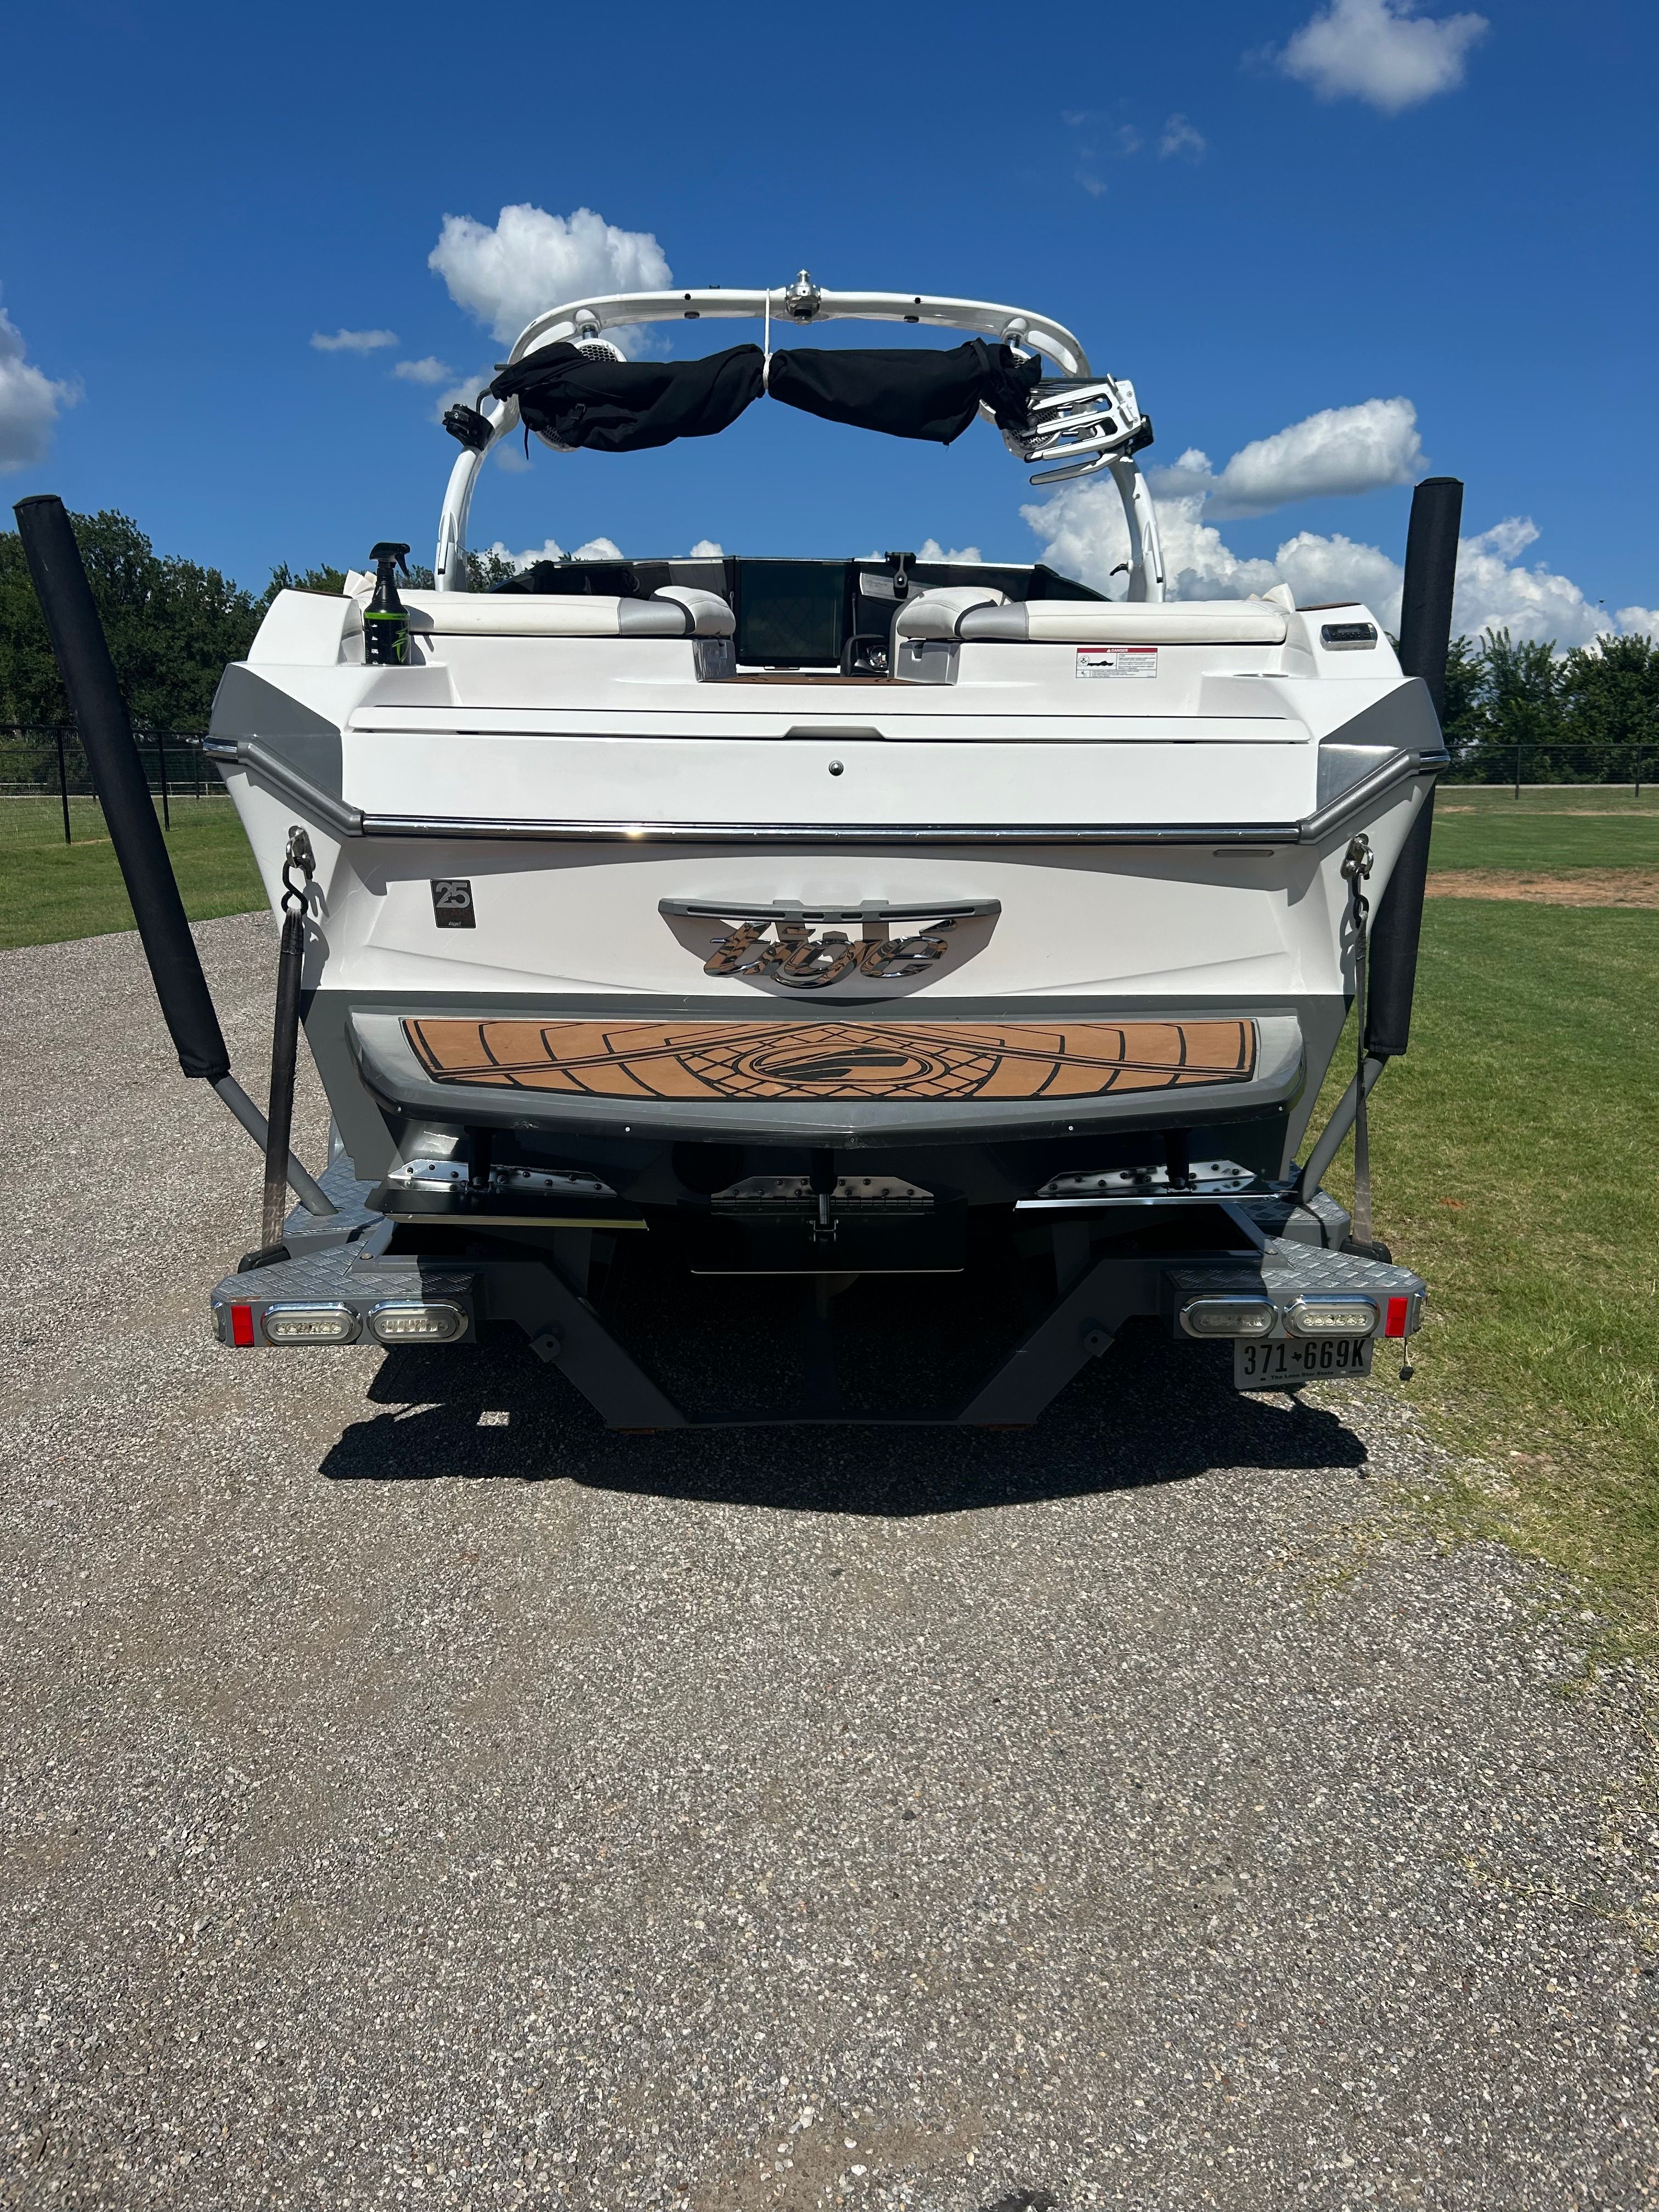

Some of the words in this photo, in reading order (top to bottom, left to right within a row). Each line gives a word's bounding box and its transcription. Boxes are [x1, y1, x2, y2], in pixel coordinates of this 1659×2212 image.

[436, 882, 471, 909] 25
[1244, 1343, 1288, 1375] 371
[1304, 1339, 1366, 1370] 669K
